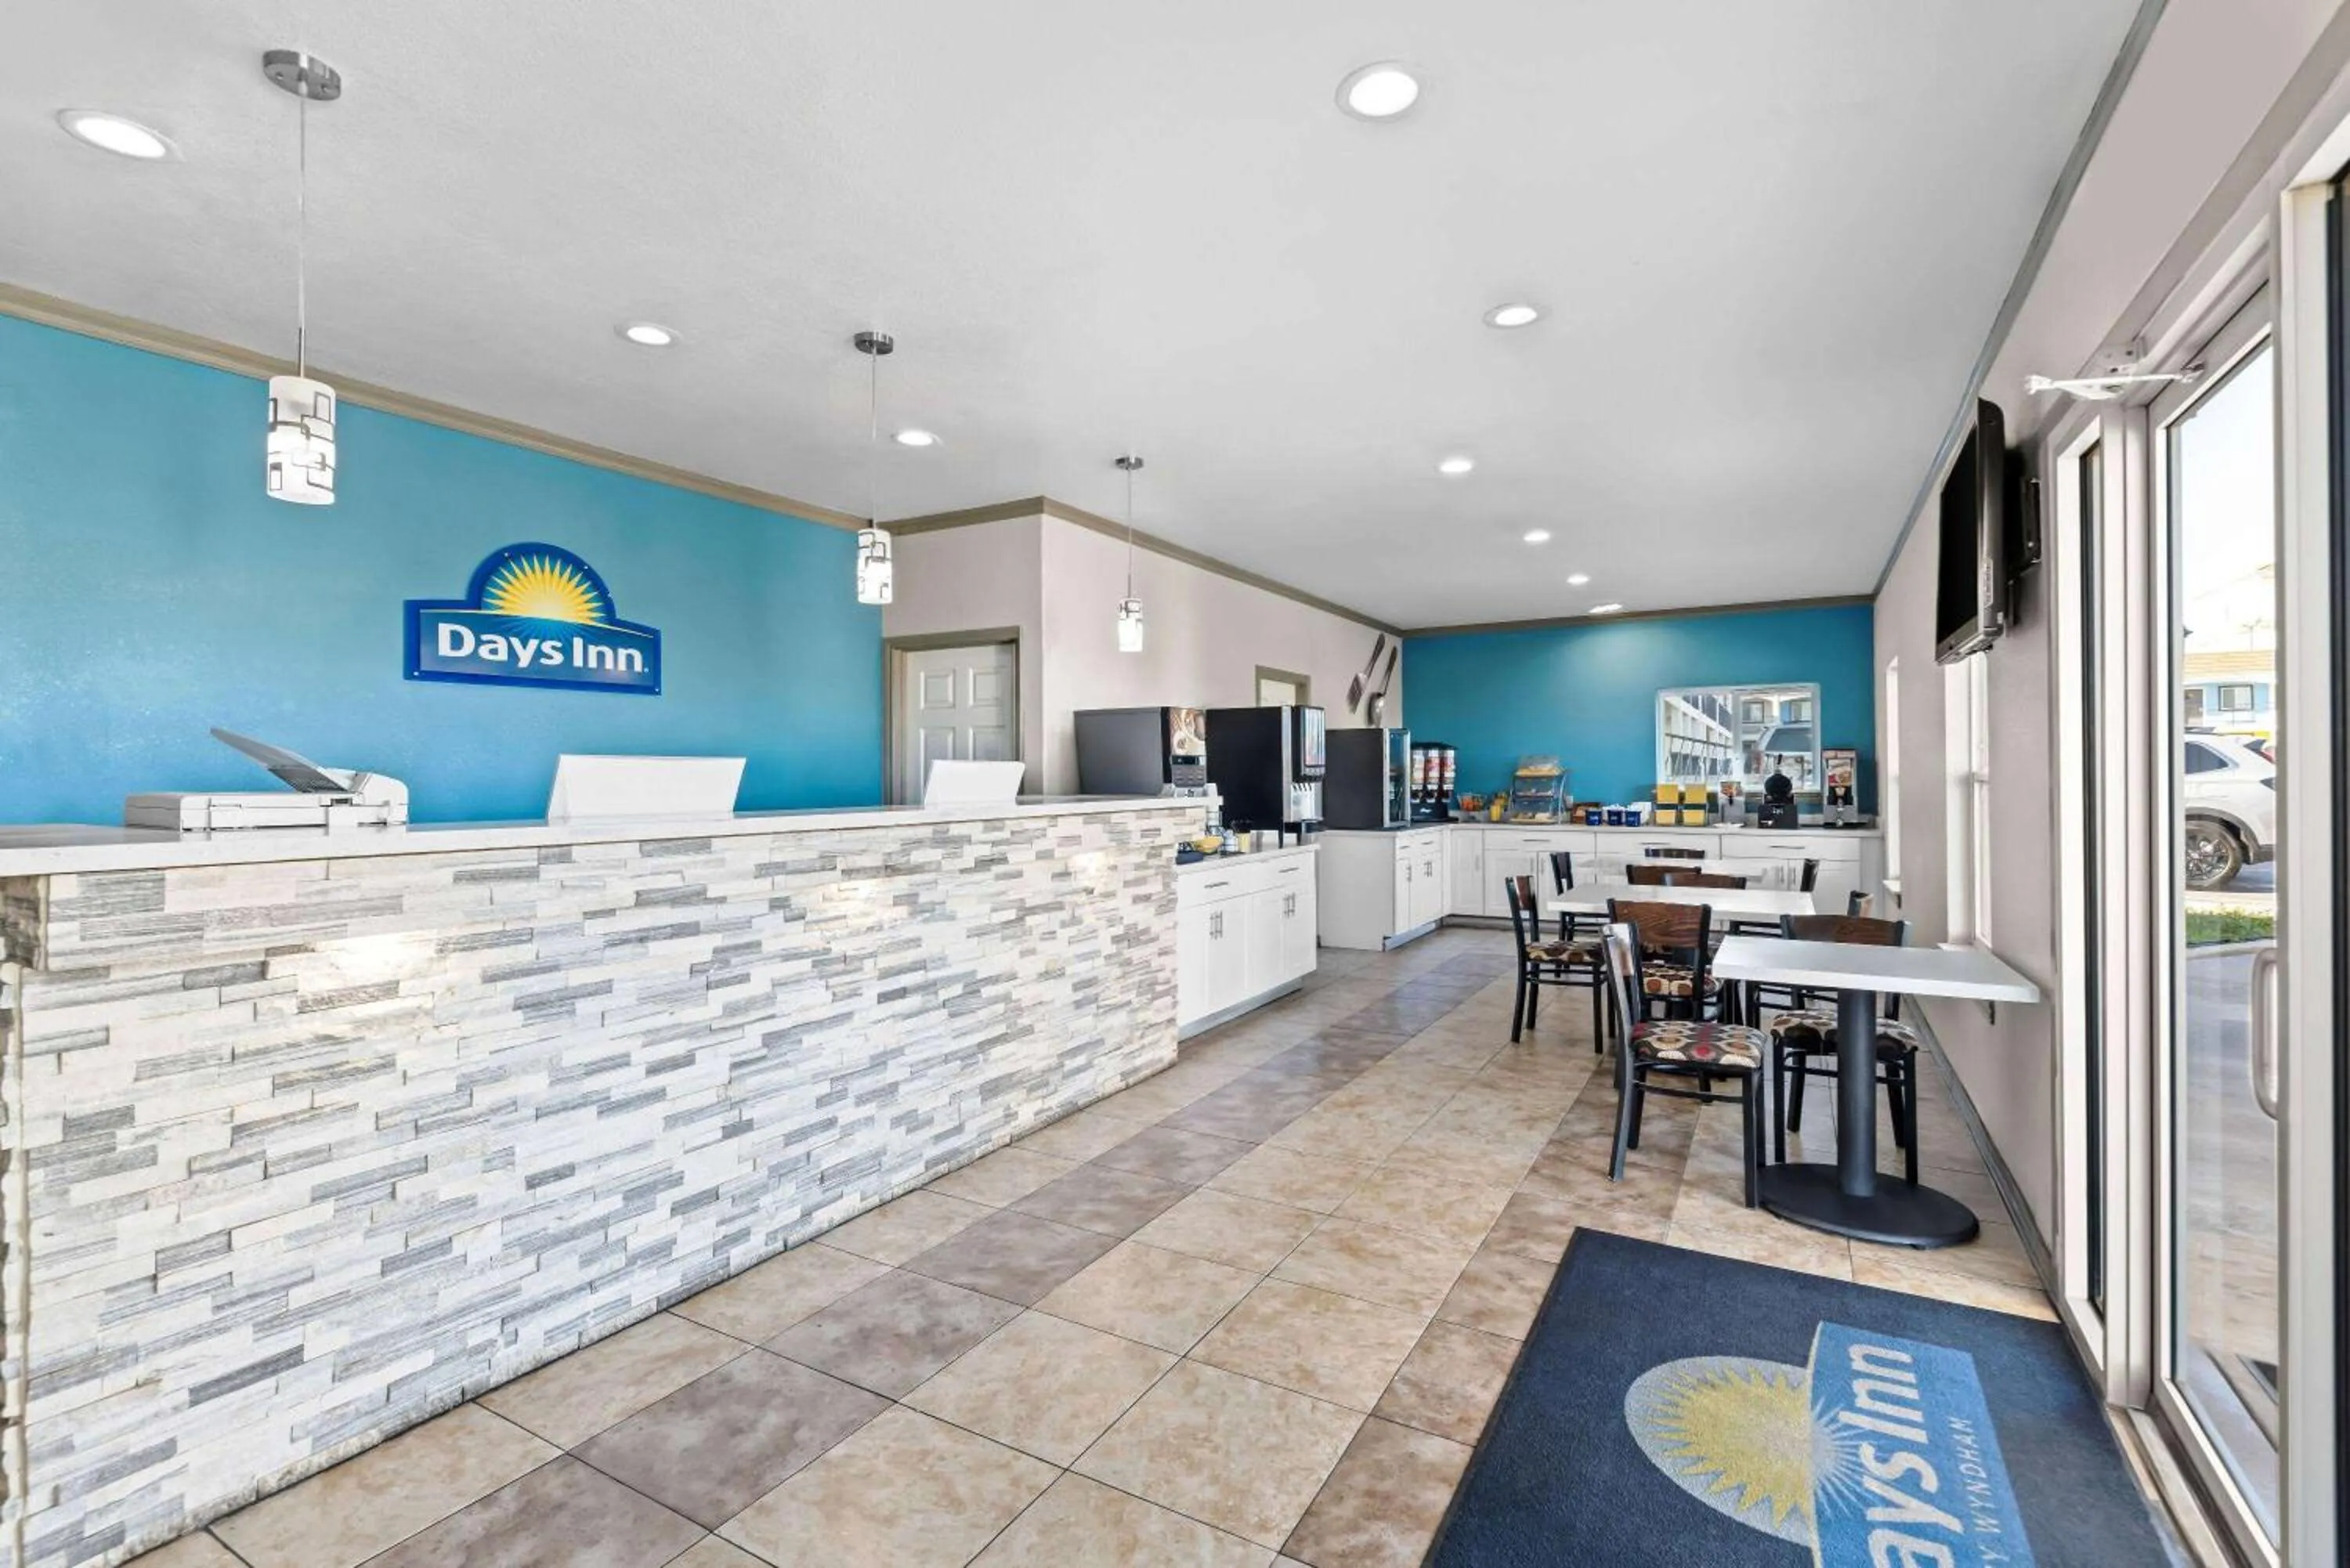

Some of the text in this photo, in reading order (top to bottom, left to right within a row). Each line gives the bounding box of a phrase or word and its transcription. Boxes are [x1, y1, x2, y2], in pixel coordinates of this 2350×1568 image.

[438, 623, 643, 673] Days Inn
[1837, 1343, 1964, 1568] ays Inn
[1947, 1416, 2011, 1568] Y WYNDHAM
